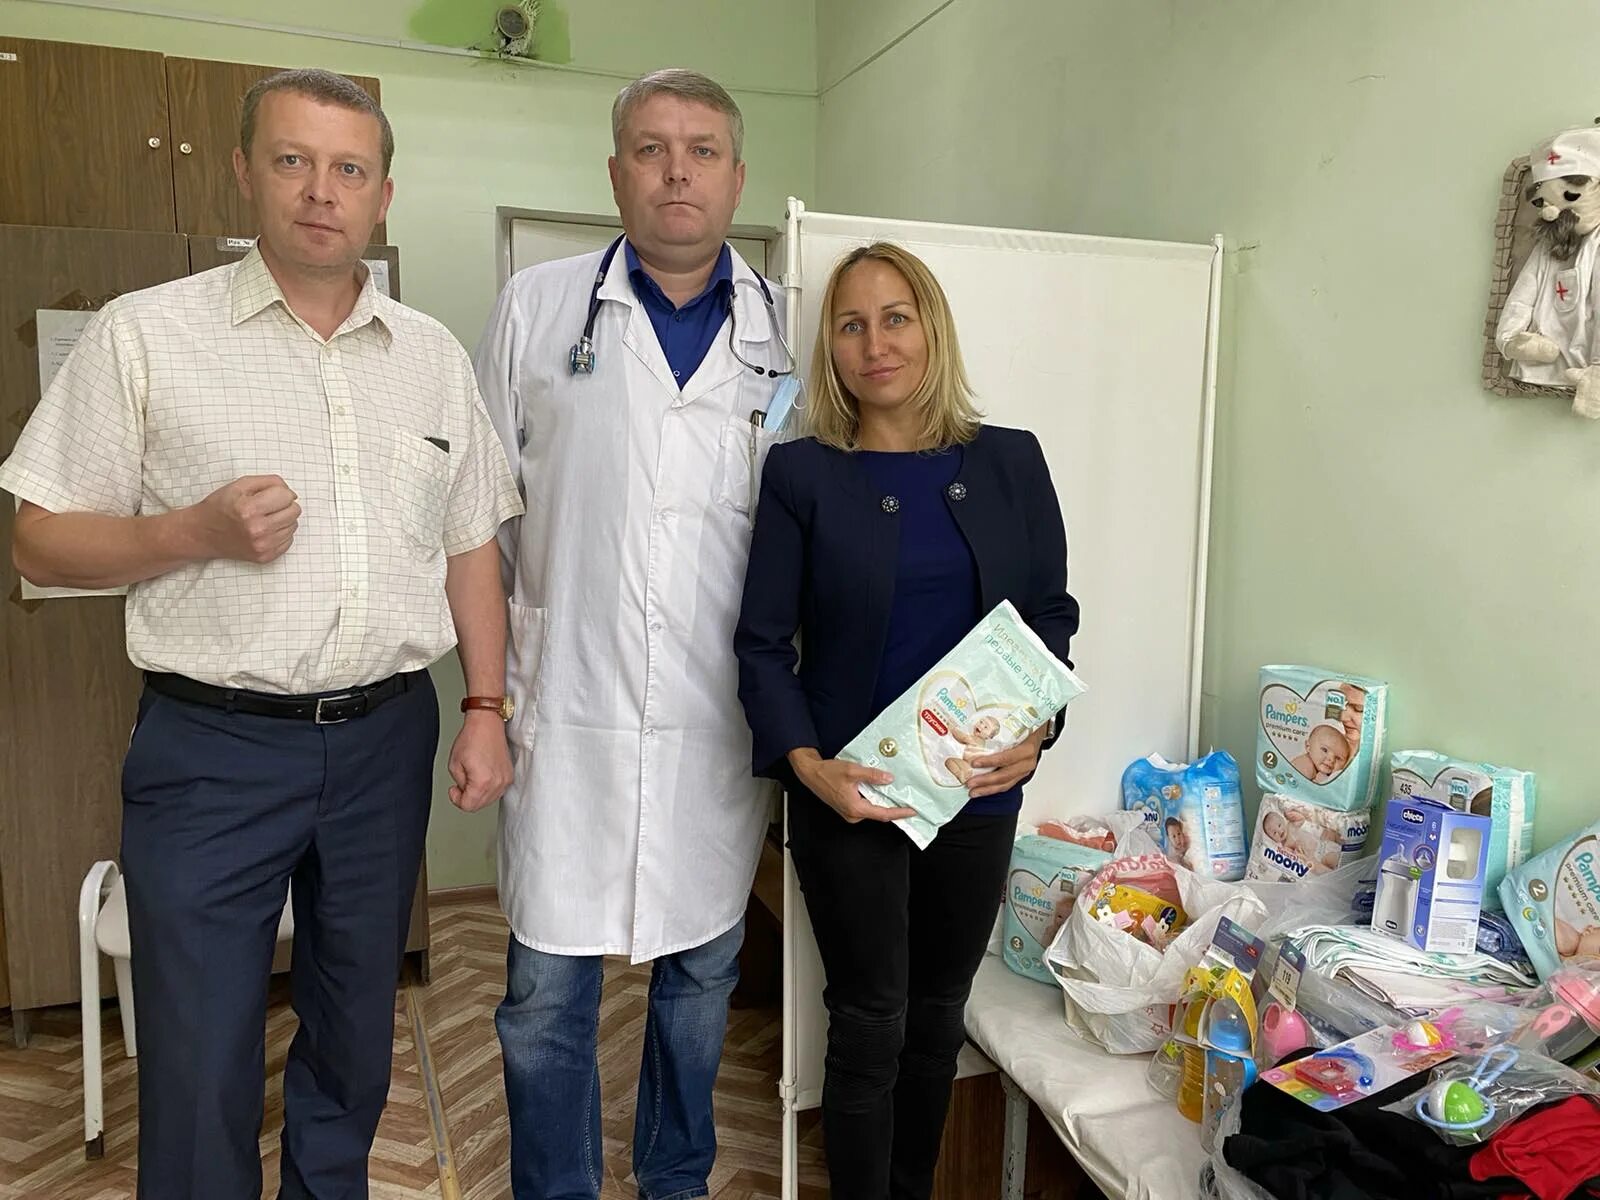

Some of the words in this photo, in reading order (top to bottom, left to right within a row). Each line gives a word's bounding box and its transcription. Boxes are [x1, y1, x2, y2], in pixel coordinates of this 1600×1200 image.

[985, 634, 1022, 674] первые
[1023, 672, 1059, 714] трусики
[936, 687, 967, 723] Pampers
[1265, 703, 1308, 728] Pampers
[1265, 722, 1292, 733] premium
[1292, 729, 1306, 737] care
[884, 740, 896, 753] 3
[1266, 753, 1274, 765] 2
[1400, 783, 1412, 796] 435
[1403, 810, 1424, 823] chicco
[1264, 847, 1310, 877] moony
[1565, 862, 1589, 901] premium
[1533, 884, 1547, 897] 2
[1014, 886, 1052, 911] Pampers
[1013, 938, 1021, 949] 3
